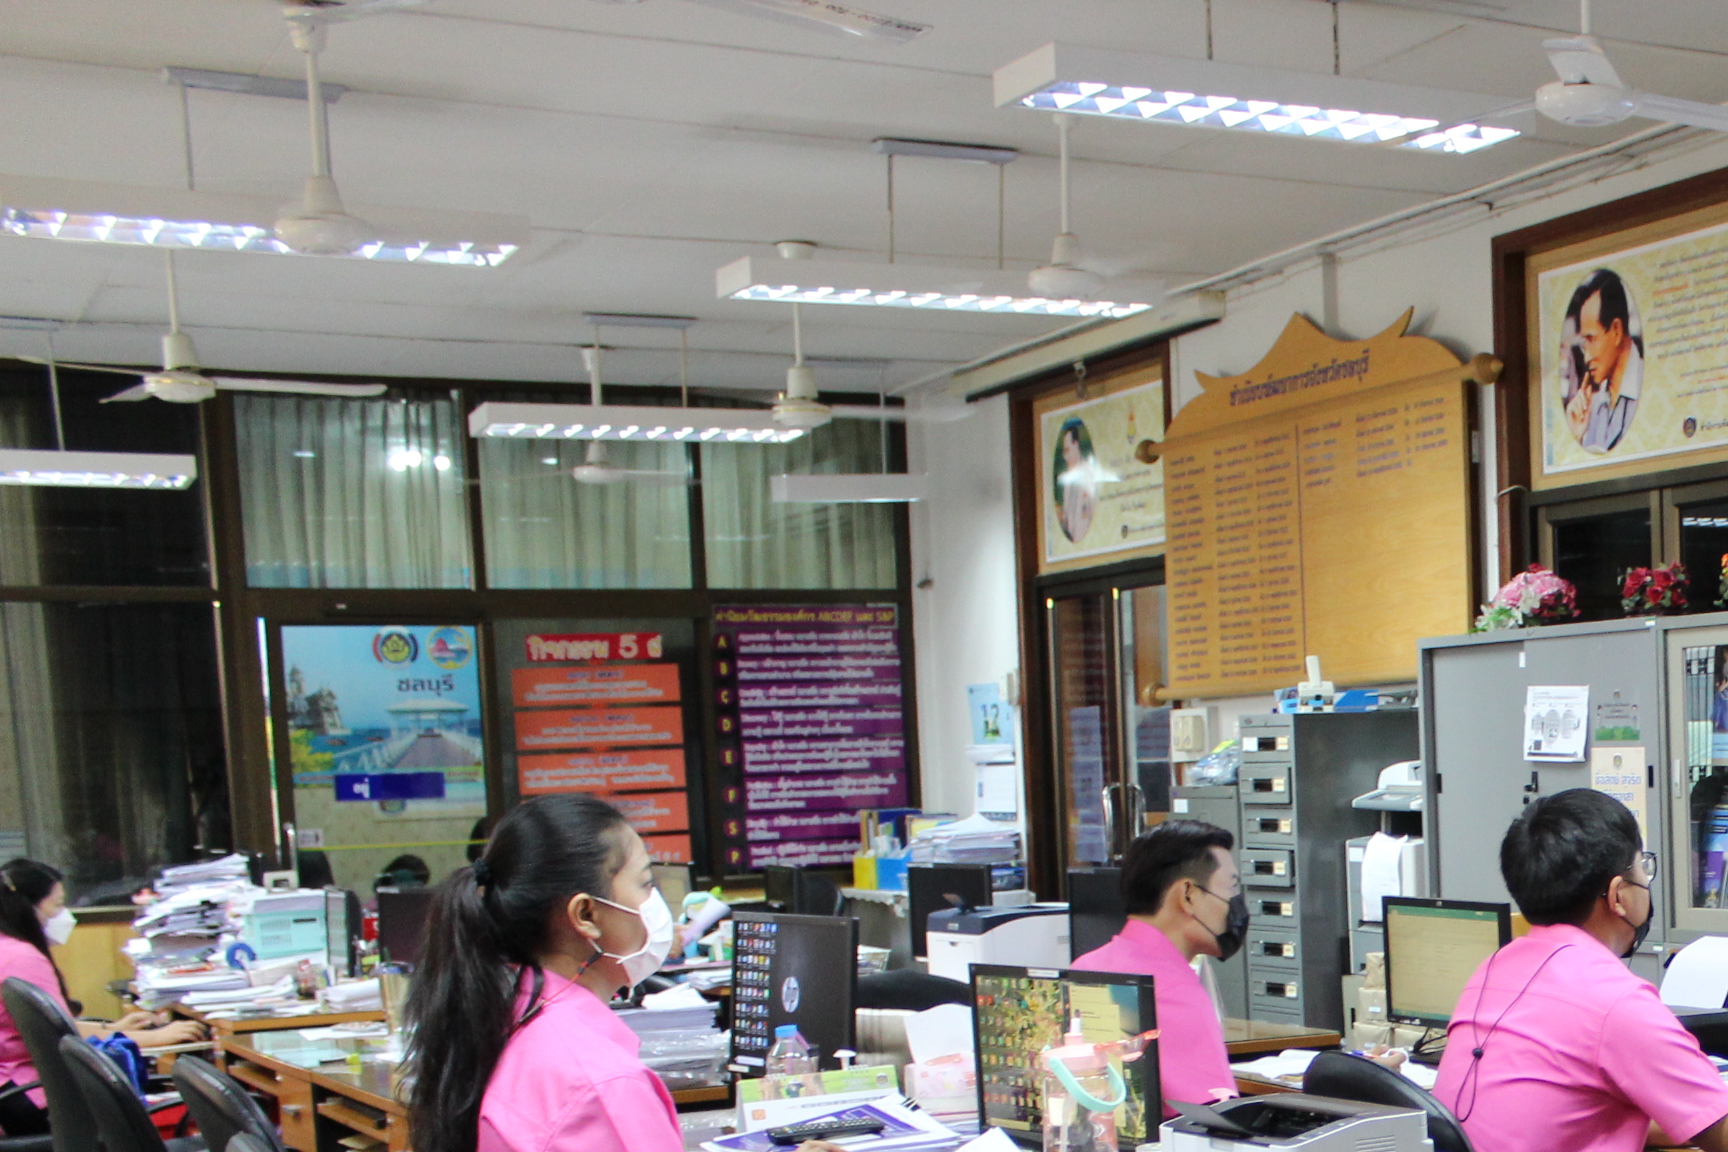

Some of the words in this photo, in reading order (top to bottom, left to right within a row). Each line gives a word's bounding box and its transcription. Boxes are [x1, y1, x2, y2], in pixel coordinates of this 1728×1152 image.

[618, 634, 639, 659] 5
[397, 673, 455, 696] ชลบุรี
